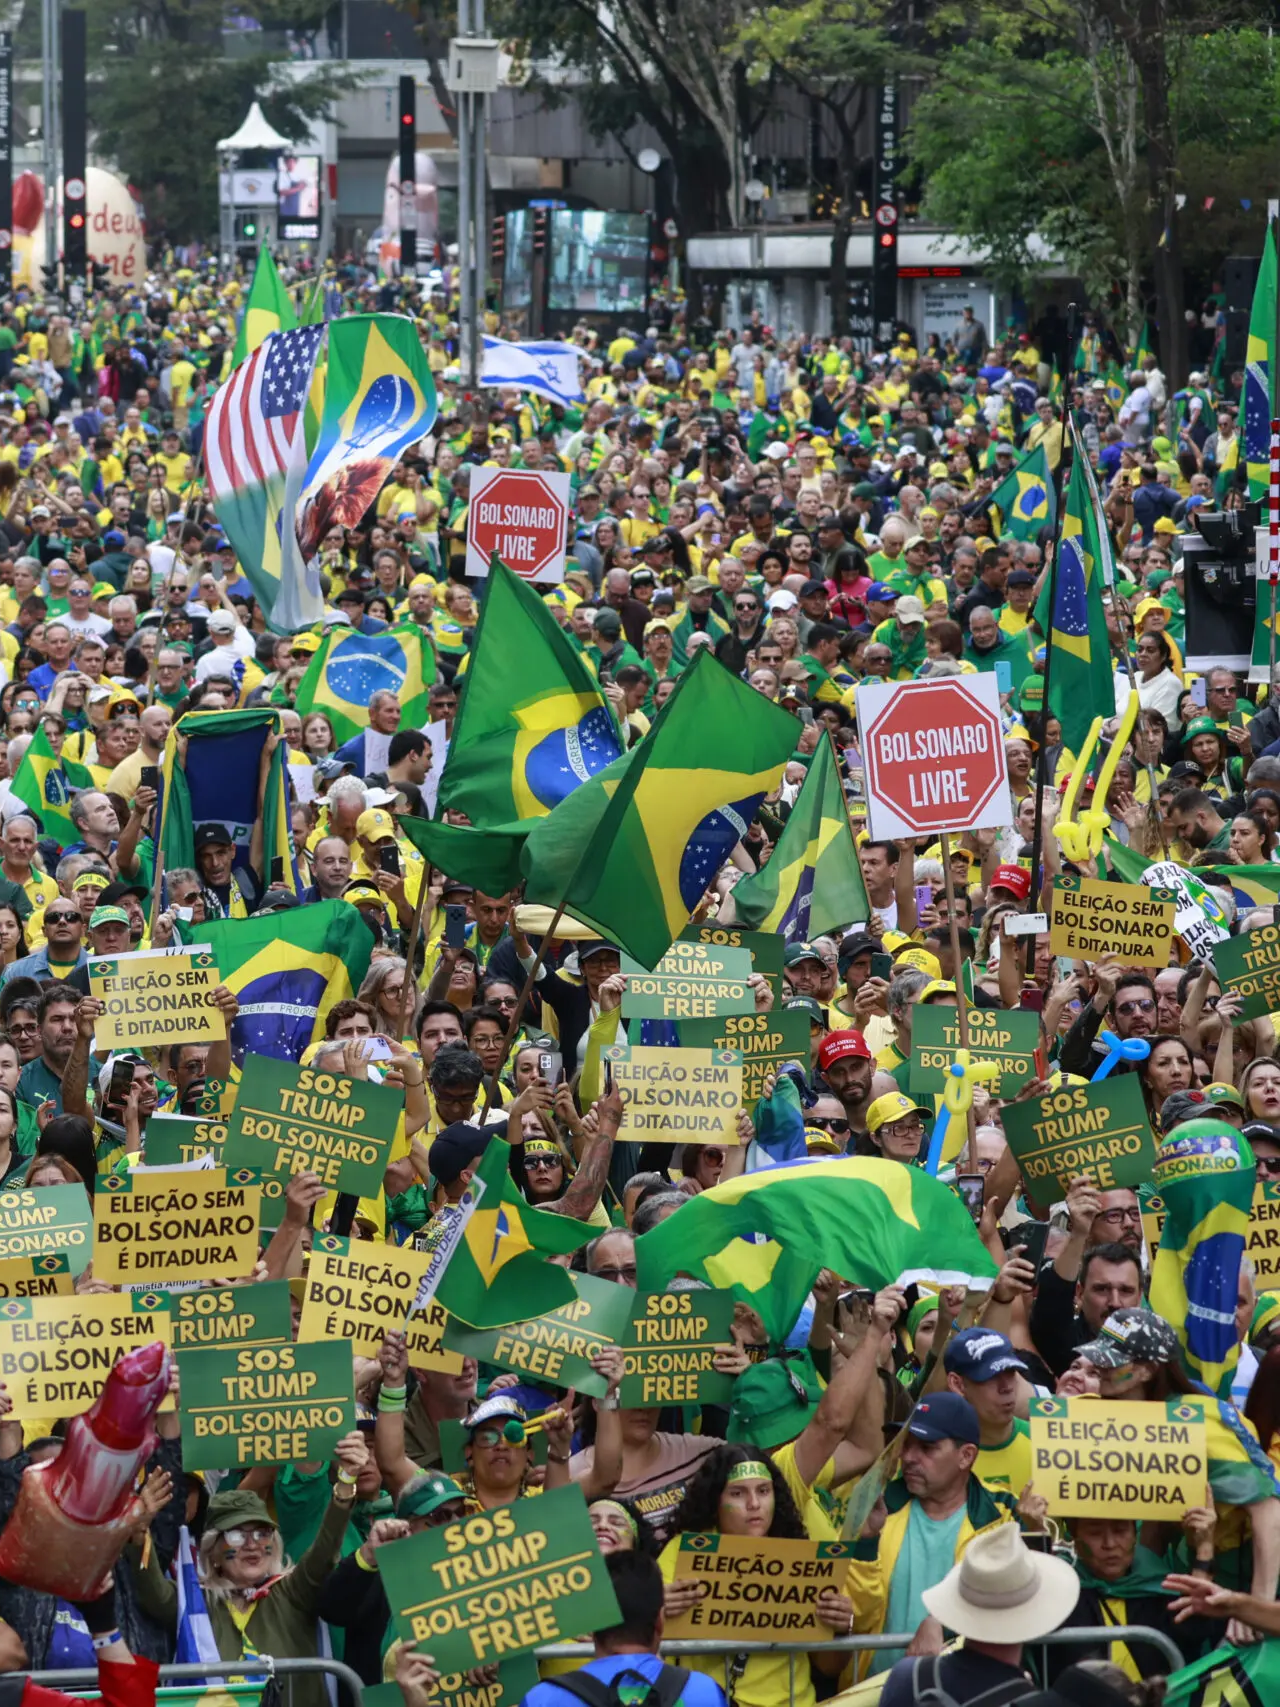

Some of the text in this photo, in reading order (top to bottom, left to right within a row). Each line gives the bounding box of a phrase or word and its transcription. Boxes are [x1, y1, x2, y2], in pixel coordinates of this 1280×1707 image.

[479, 502, 556, 530] BOLSONARO
[495, 533, 537, 561] LIVRE
[879, 722, 989, 765] BOLSONARO
[908, 767, 970, 808] LIVRE
[1063, 892, 1164, 918] ELEIÇÃO SEM
[699, 928, 742, 947] SOS
[1054, 911, 1170, 939] BOLSONARO
[1067, 929, 1155, 958] É DITADURA
[656, 958, 724, 976] TRUMP
[102, 970, 209, 994] ELEIÇÃO SEM
[631, 980, 745, 999] BOLSONARO
[98, 990, 216, 1017] BOLSONARO
[663, 998, 717, 1017] FREE
[114, 1015, 210, 1037] É DITADURA
[725, 1015, 768, 1035] SOS
[713, 1033, 784, 1054] TRUMP
[297, 1069, 353, 1099] SOS
[613, 1062, 688, 1085] ELEIÇÃO
[691, 1066, 729, 1084] SEM
[279, 1088, 366, 1129] TRUMP
[1039, 1089, 1089, 1118] SOS
[633, 1114, 724, 1132] DITADURA
[1032, 1106, 1111, 1145] TRUMP
[240, 1116, 378, 1165] BOLSONARO
[273, 1147, 342, 1185] FREE
[1024, 1134, 1142, 1179] BOLSONARO
[109, 1189, 245, 1217] ELEIÇÃO SEM
[97, 1214, 256, 1244] BOLSONARO
[118, 1245, 238, 1270] É DITADURA
[324, 1254, 412, 1289] ELEIÇÃO
[15, 1277, 59, 1298] SEM
[178, 1291, 235, 1317] SOS
[646, 1293, 692, 1317] SOS
[11, 1314, 155, 1346] ELEIÇÃO SEM
[170, 1313, 256, 1344] TRUMP
[325, 1311, 336, 1335] É
[633, 1316, 709, 1343] TRUMP
[236, 1347, 296, 1373] SOS
[493, 1335, 565, 1379] FREE
[26, 1379, 38, 1403] É
[221, 1371, 318, 1401] TRUMP
[642, 1374, 699, 1402] FREE
[194, 1406, 344, 1437] BOLSONARO
[1046, 1418, 1189, 1447] ELEIÇÃO SEM
[237, 1431, 308, 1463] FREE
[1036, 1448, 1202, 1476] BOLSONARO
[1058, 1475, 1186, 1504] É DITADURA
[443, 1508, 517, 1554] SOS
[431, 1531, 548, 1591] TRUMP
[691, 1553, 834, 1579] ELEIÇÃO SEM
[410, 1565, 593, 1642] BOLSONARO
[690, 1603, 816, 1630] É DITADURA
[468, 1604, 560, 1661] FREE
